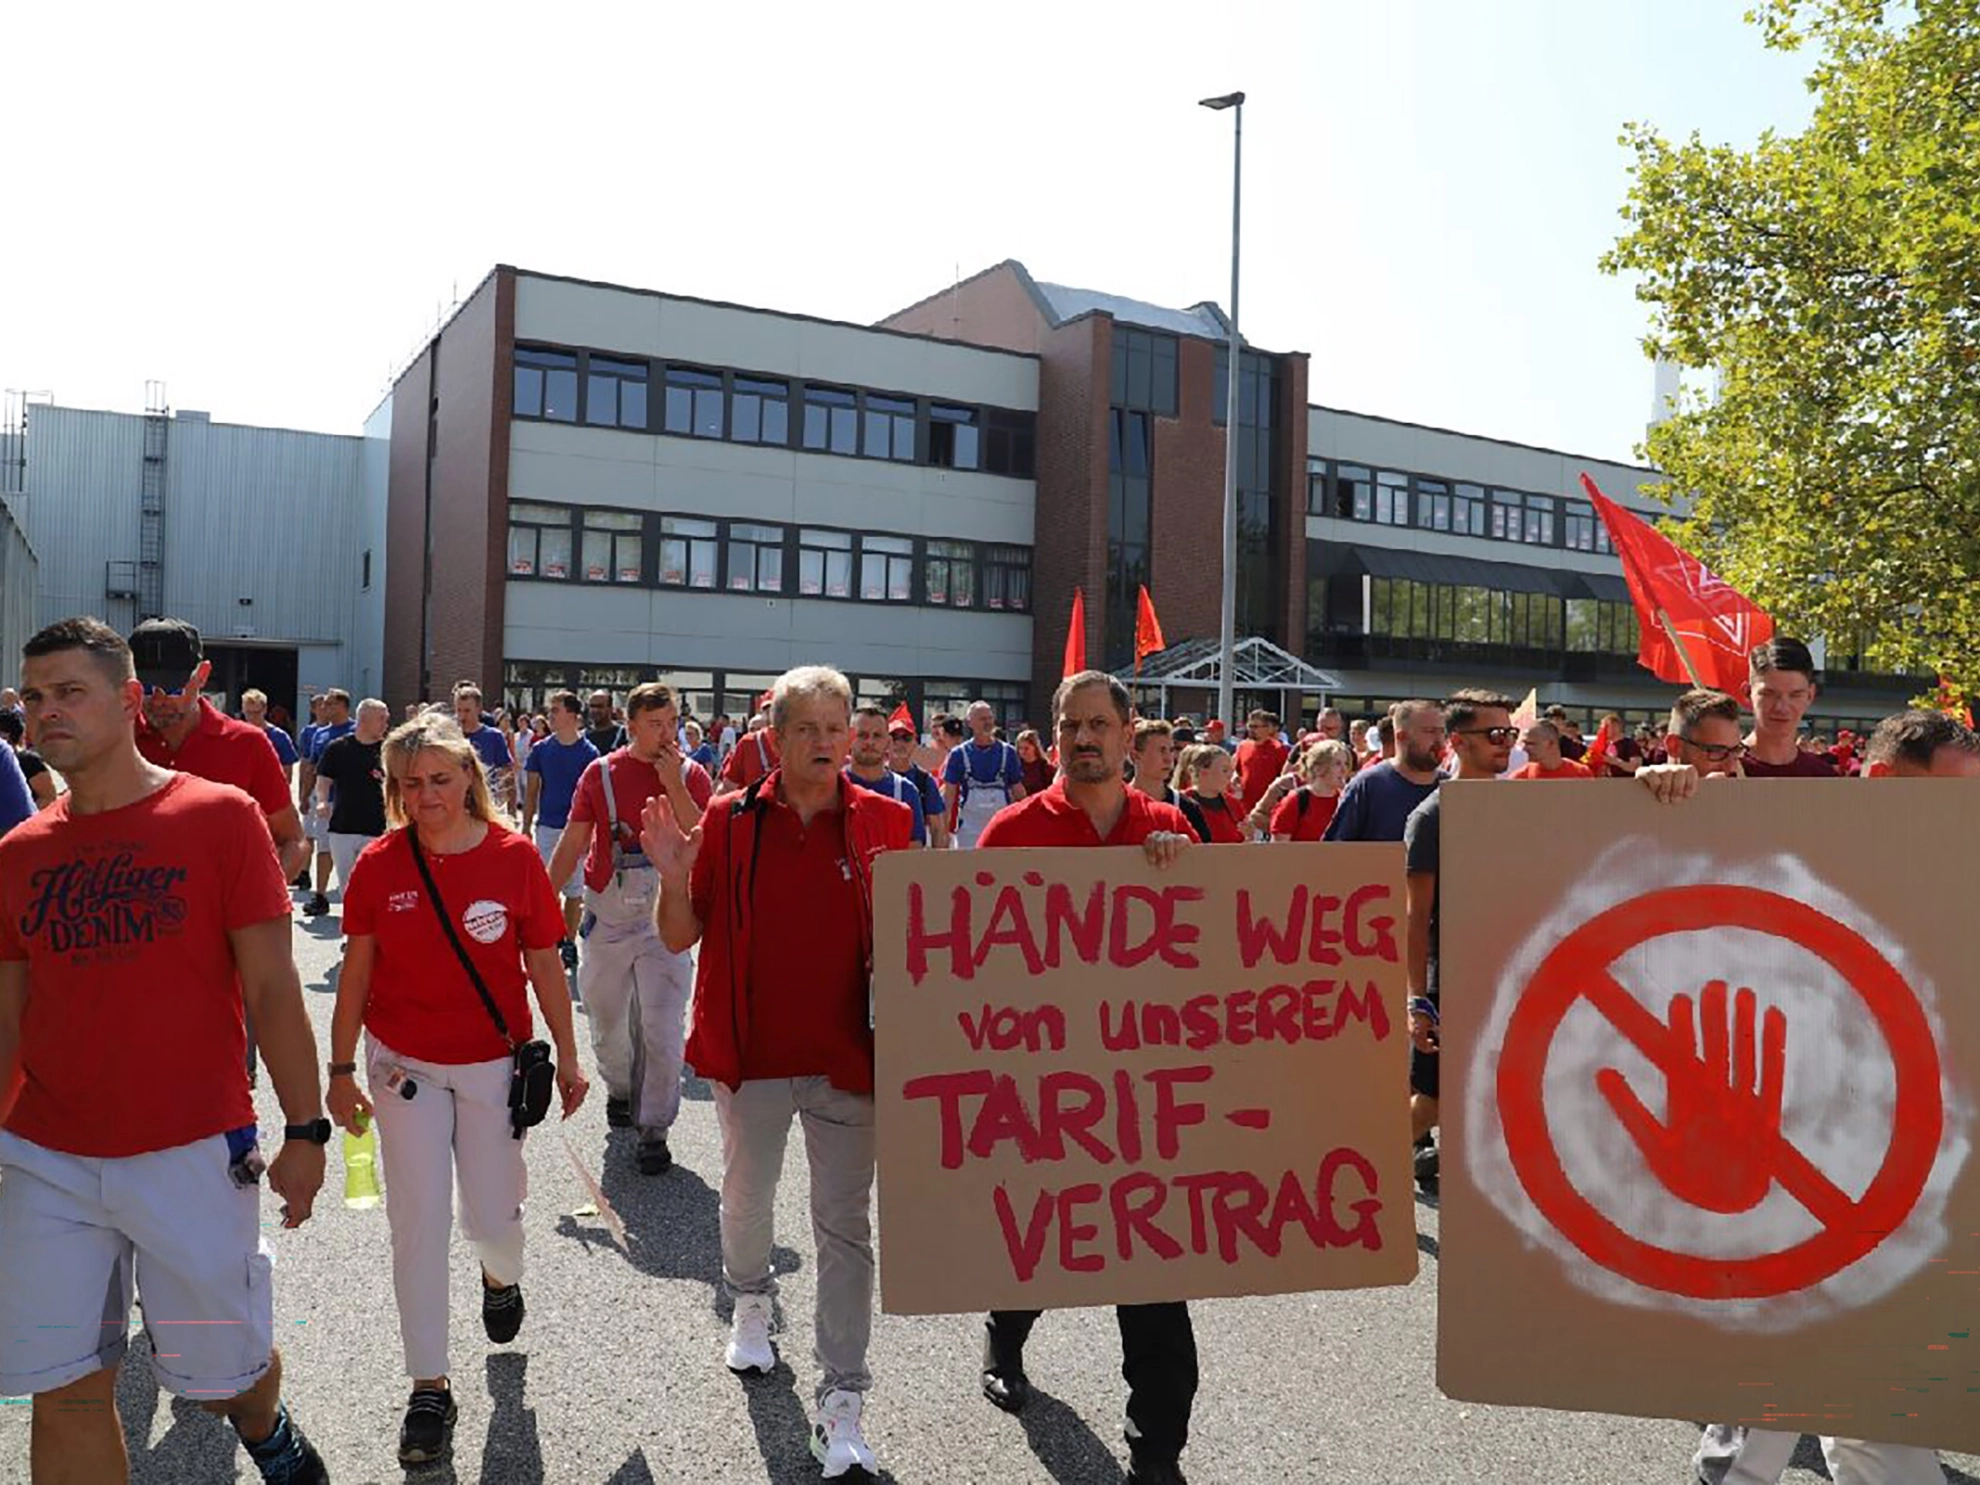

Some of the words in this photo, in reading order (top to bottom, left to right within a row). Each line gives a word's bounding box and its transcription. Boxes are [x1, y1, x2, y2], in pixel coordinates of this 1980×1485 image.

[49, 904, 154, 952] DENIM
[907, 872, 1205, 985] HÄNDE
[1236, 884, 1398, 967] WEG
[960, 1003, 1066, 1051] von
[994, 1148, 1383, 1281] VERTRAG
